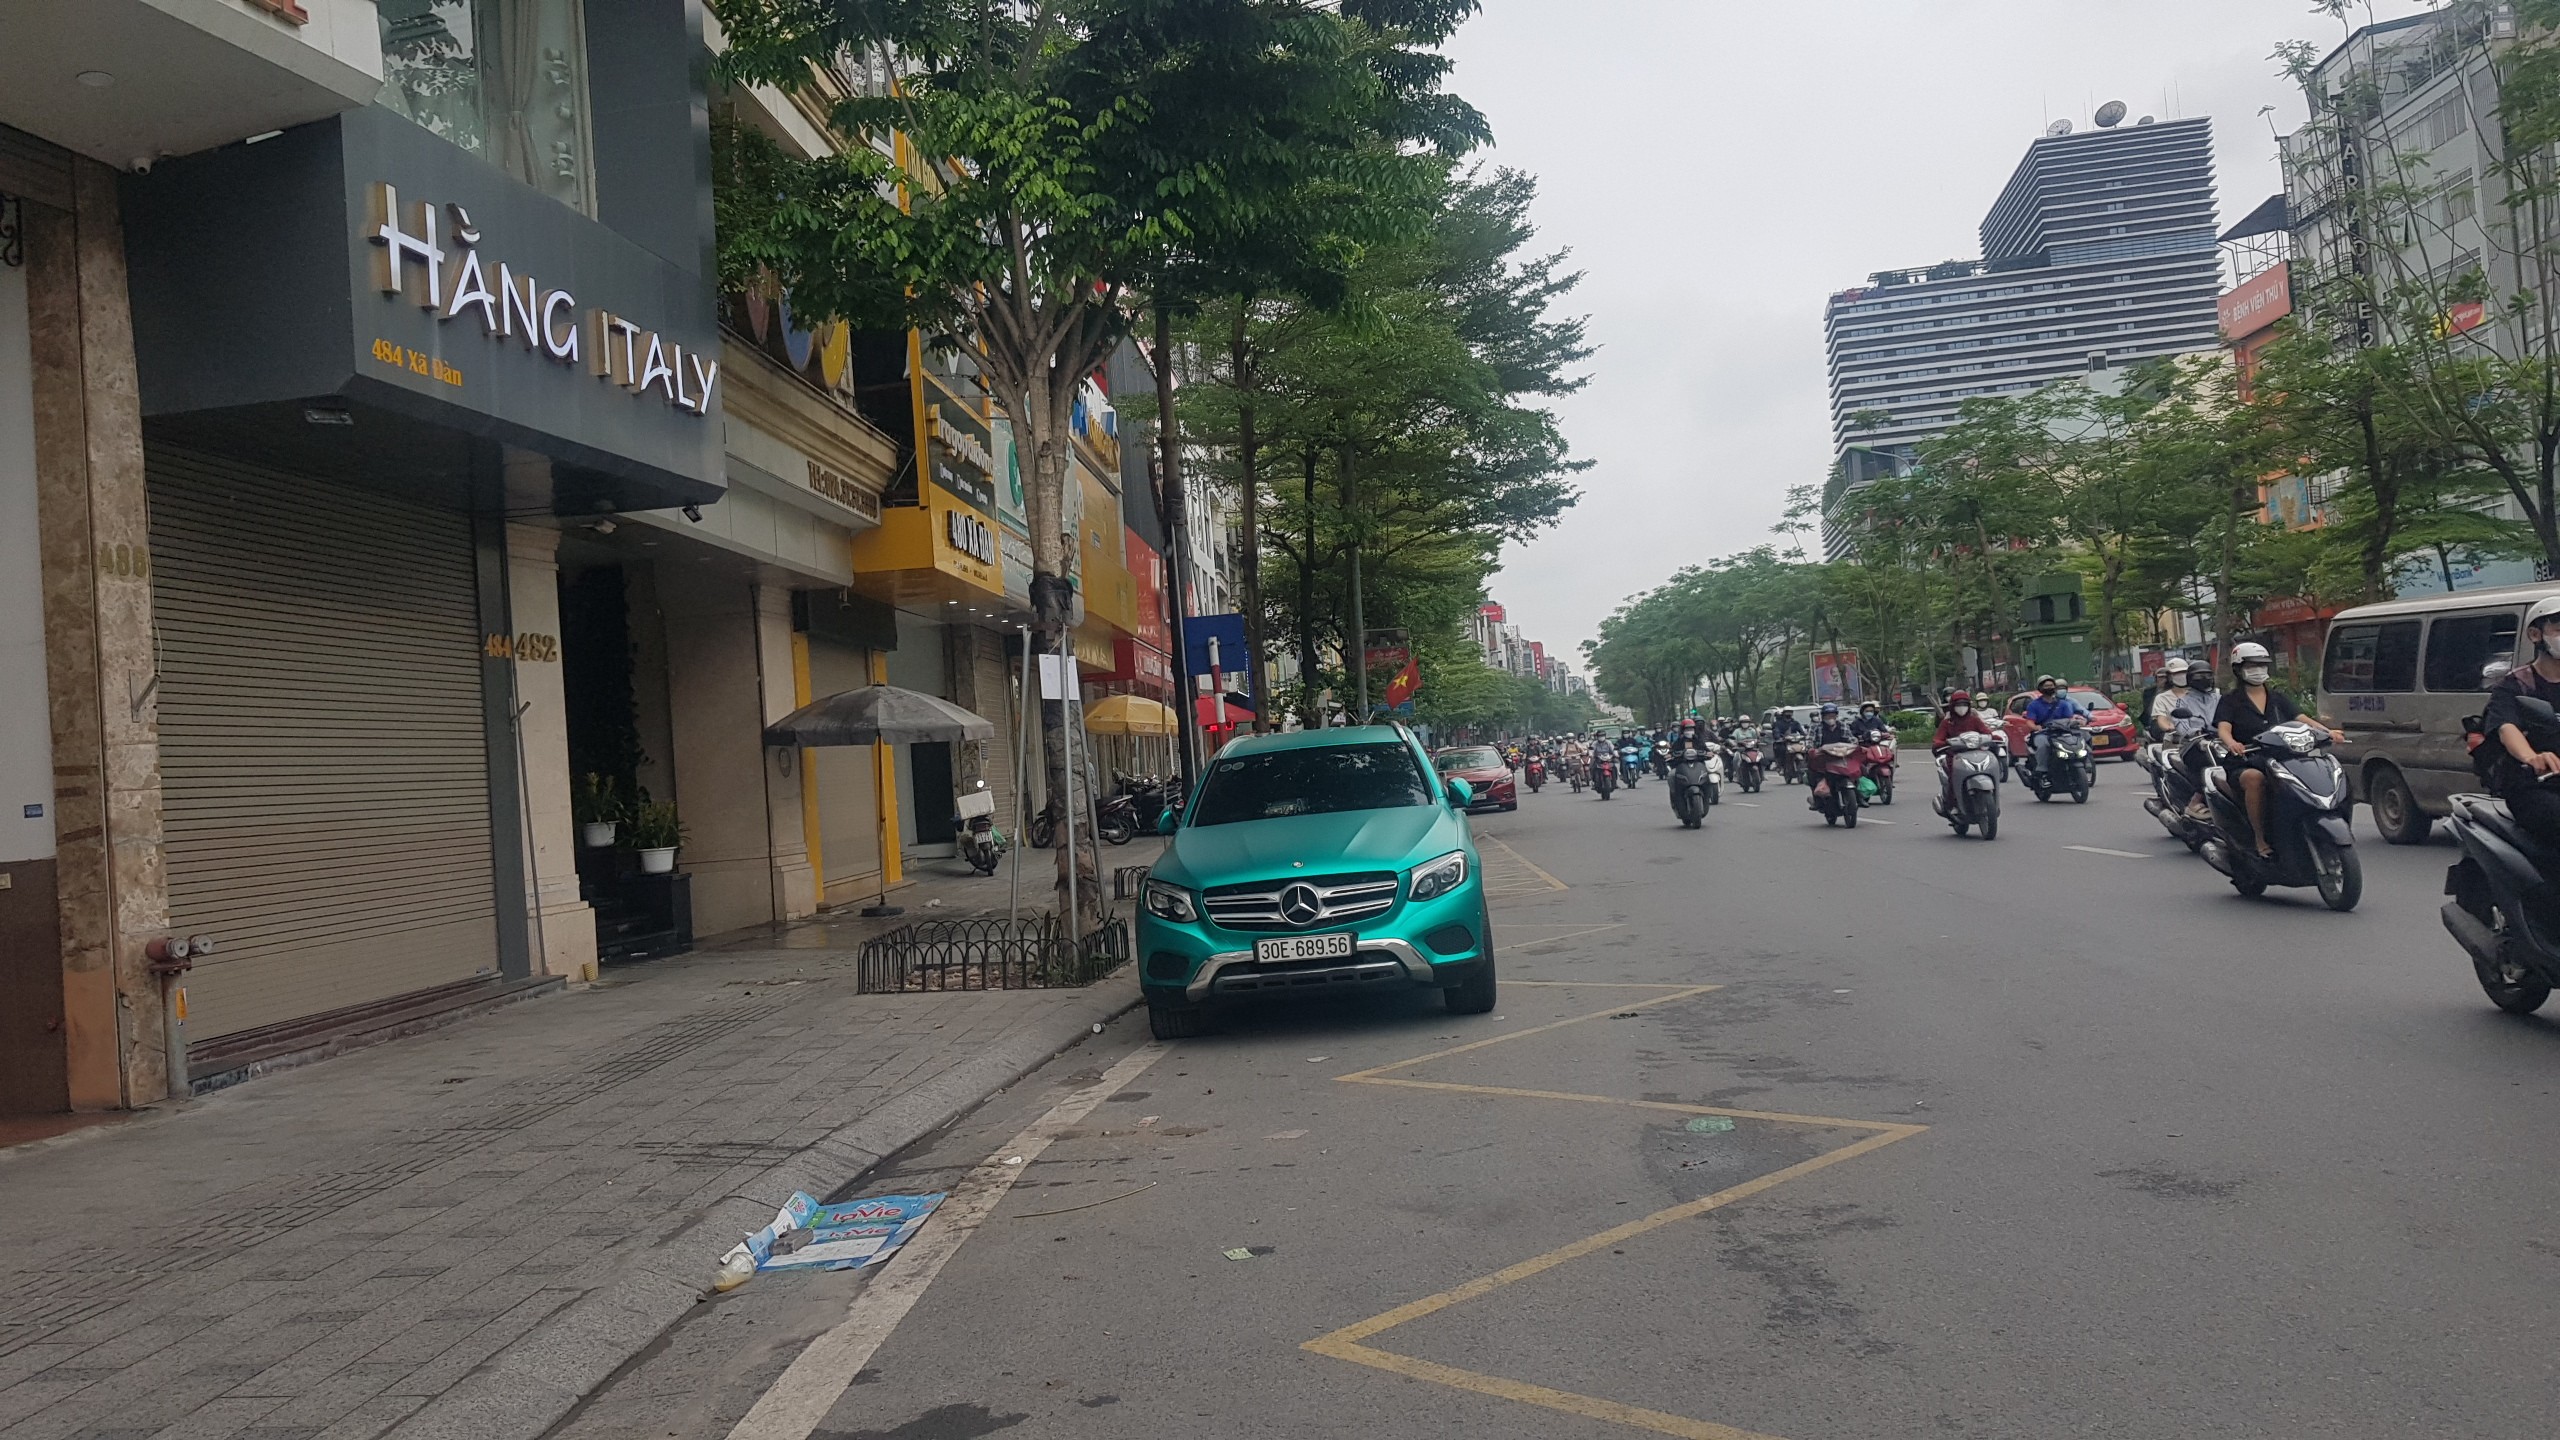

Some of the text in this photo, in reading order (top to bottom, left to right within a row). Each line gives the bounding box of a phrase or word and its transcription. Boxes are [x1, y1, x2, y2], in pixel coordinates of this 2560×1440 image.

[376, 183, 718, 415] HẰNG ITALY
[2250, 289, 2265, 314] VIỆN
[2279, 280, 2284, 297] Y
[372, 338, 403, 368] 484
[406, 348, 429, 377] Xã
[950, 511, 967, 551] 480
[484, 633, 512, 658] 484
[515, 632, 558, 662] 482
[1260, 936, 1348, 960] 30E-689.56
